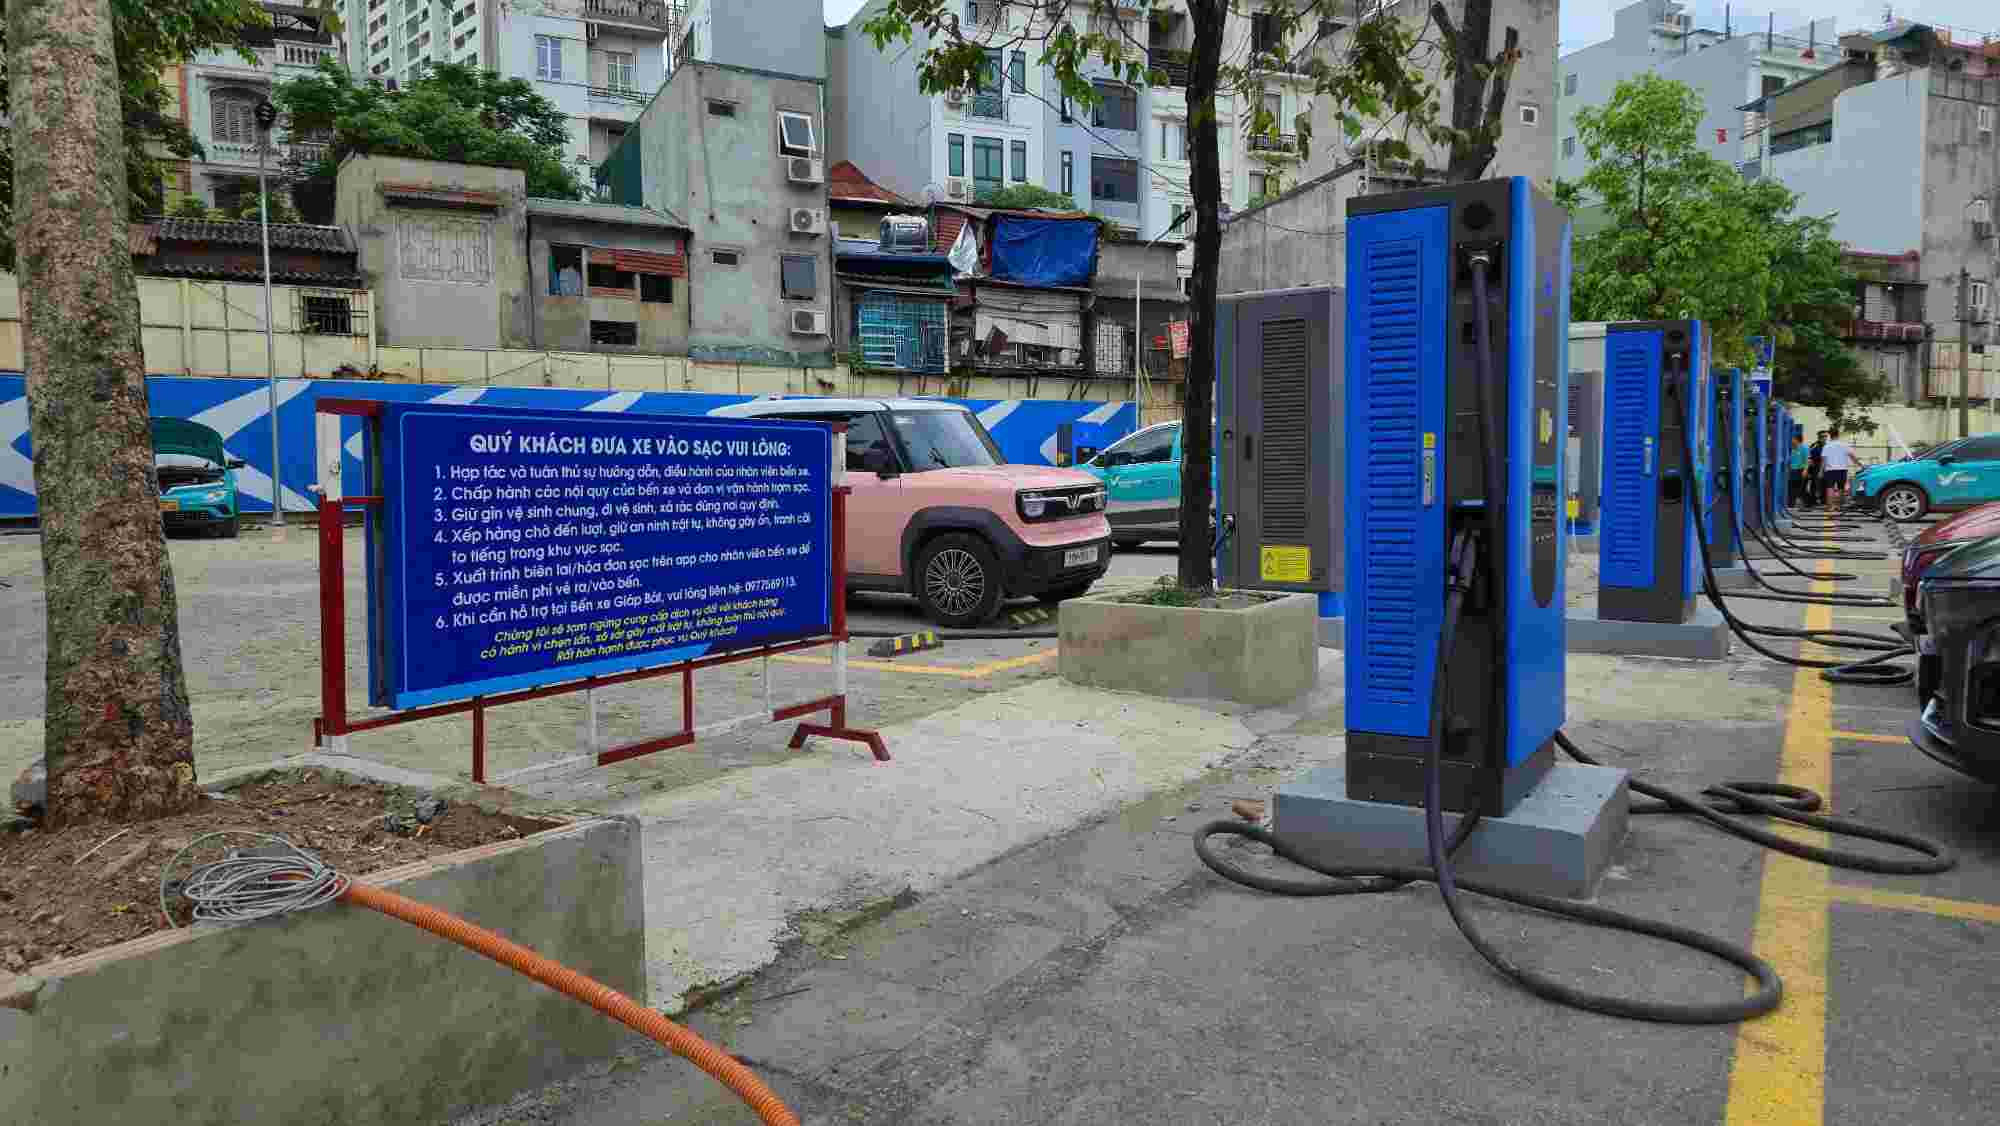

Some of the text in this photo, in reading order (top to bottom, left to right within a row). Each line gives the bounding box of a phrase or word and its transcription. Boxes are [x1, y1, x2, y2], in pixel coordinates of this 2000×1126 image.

[470, 430, 791, 459] QUÝ KHÁCH ĐƯA XE VÀO SẠC VUI LÒNG:
[435, 466, 446, 479] 1.
[484, 465, 506, 478] tác
[510, 465, 527, 478] và
[530, 466, 558, 478] tuân
[561, 465, 581, 477] thủ
[434, 488, 447, 500] 2.
[452, 484, 492, 502] Chấp
[497, 485, 530, 498] hành
[535, 485, 560, 498] các
[587, 488, 609, 498] quy
[613, 483, 635, 495] của
[638, 483, 659, 495] bến
[662, 486, 675, 495] xe
[434, 509, 447, 522] 3.
[452, 508, 477, 520] Giữ
[507, 507, 526, 521] vệ
[527, 505, 552, 518] sinh
[555, 504, 598, 519] chung,
[602, 504, 612, 516] đi
[434, 530, 447, 542] 4.
[452, 526, 481, 544] Xếp
[486, 527, 521, 542] hàng
[554, 522, 577, 537] đến
[630, 523, 644, 533] an
[648, 520, 670, 532] ninh
[452, 544, 623, 563] to tiếng trong khu vực sạc.
[435, 573, 448, 587] 5.
[453, 568, 485, 584] Xuất
[491, 567, 520, 582] trình
[630, 558, 648, 570] sạc
[676, 555, 696, 567] app
[699, 552, 718, 564] cho
[453, 592, 490, 608] được
[495, 585, 528, 601] miễn
[532, 583, 552, 600] phí
[575, 578, 615, 593] ra/vào
[617, 575, 642, 588] bến.
[436, 616, 448, 629] 6.
[454, 612, 475, 626] Khi
[552, 602, 567, 615] tại
[571, 598, 593, 613] Bến
[597, 600, 610, 609] xe
[614, 594, 641, 608] Giáp
[668, 589, 682, 601] vui
